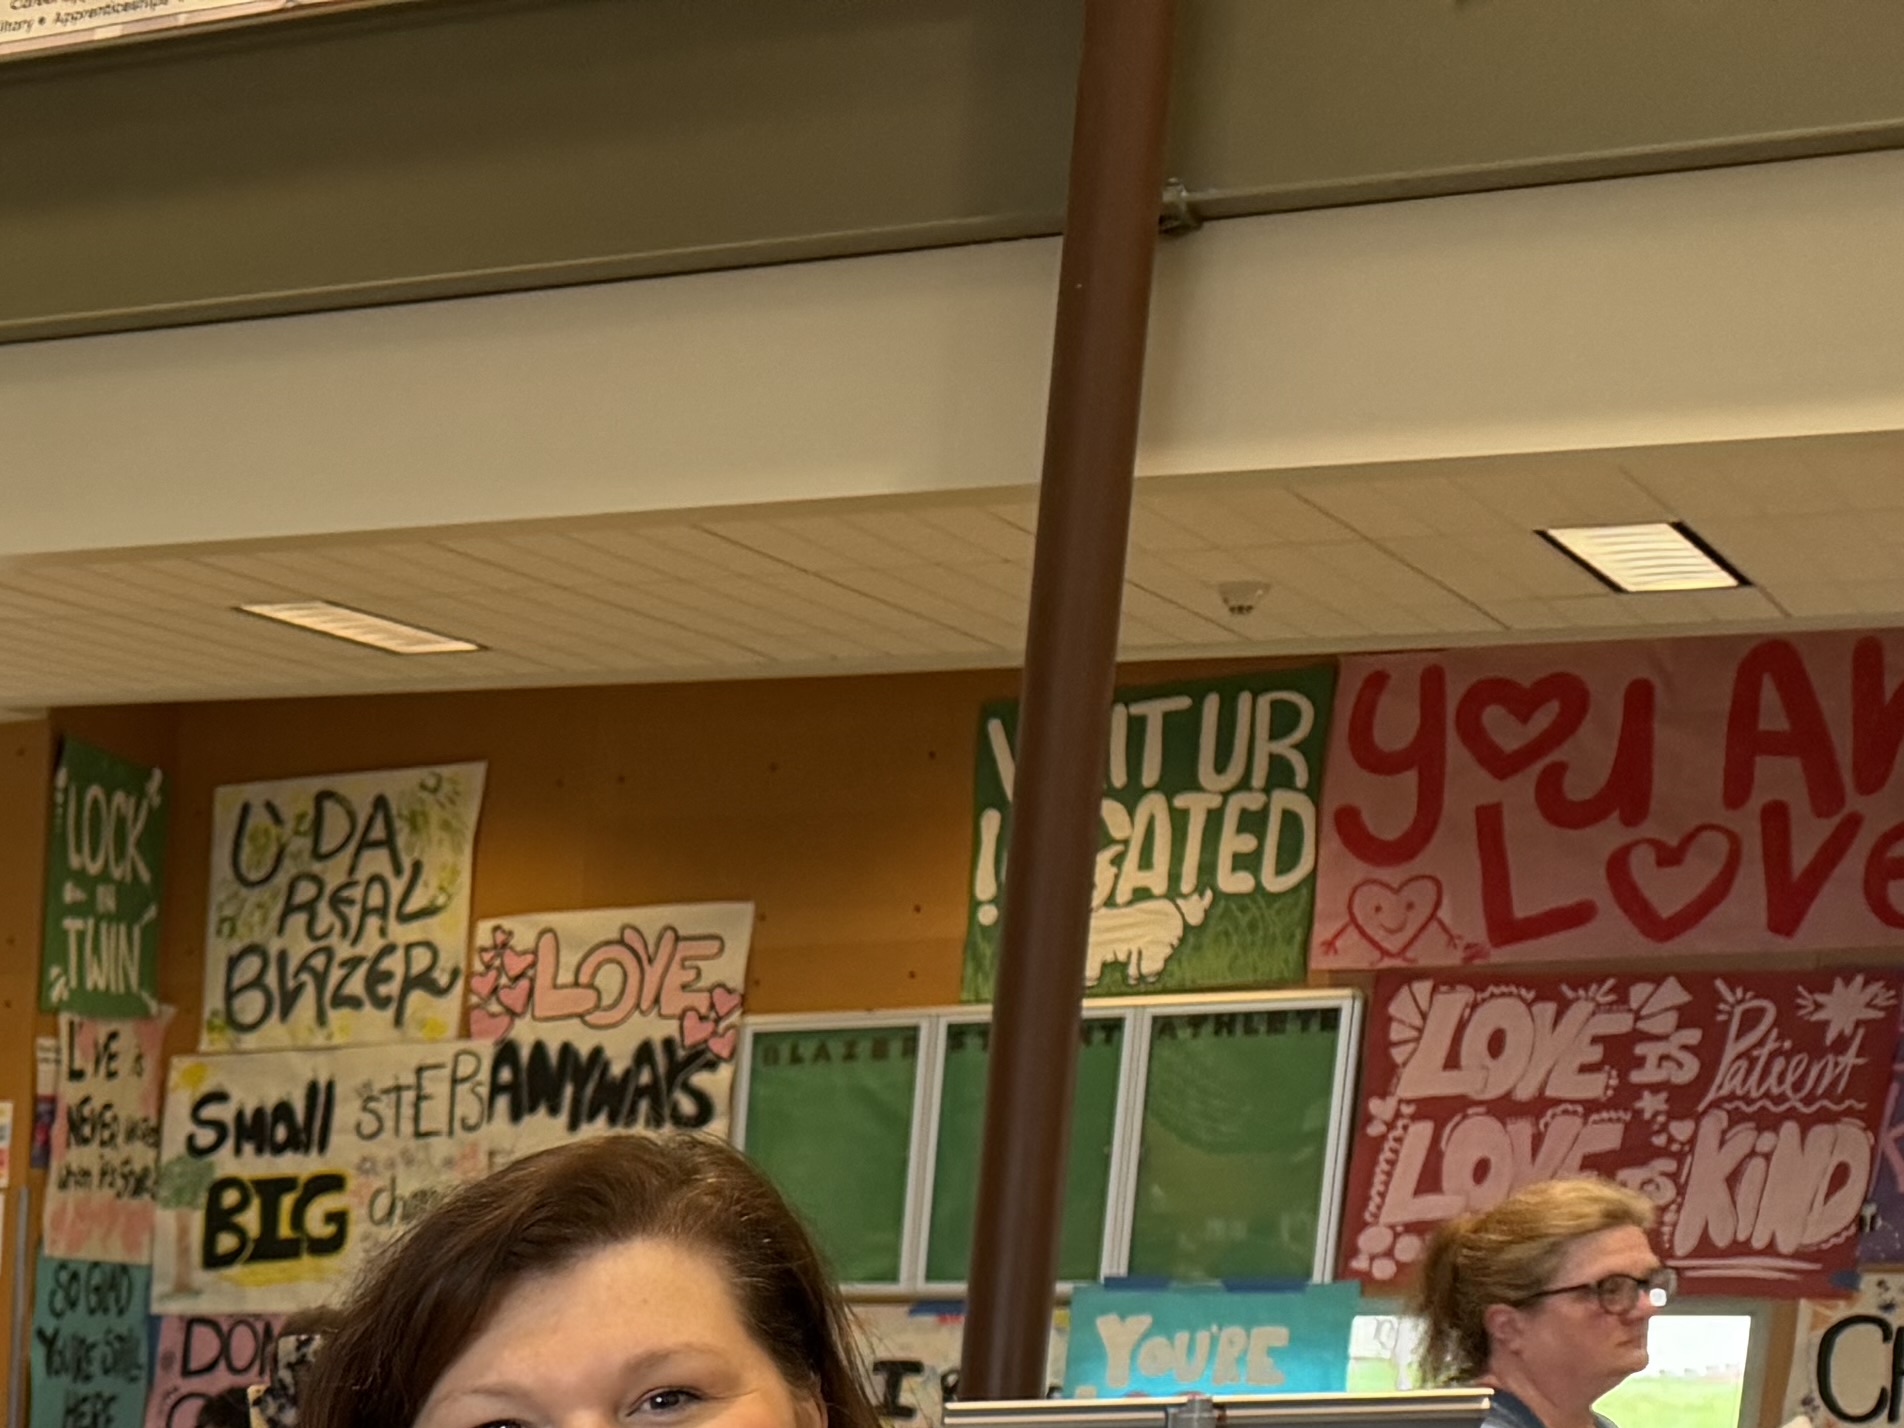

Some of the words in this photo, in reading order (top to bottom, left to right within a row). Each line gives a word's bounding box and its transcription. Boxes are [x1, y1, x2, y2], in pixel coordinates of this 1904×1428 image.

[1197, 688, 1317, 795] UR
[66, 783, 152, 884] LOCK
[231, 800, 285, 888] U
[277, 859, 450, 948] REAL
[224, 941, 461, 1033] BLAZER
[532, 924, 724, 1029] LOVE
[490, 1037, 719, 1133] ANYWAYS
[1395, 989, 1636, 1101] LOVE
[1698, 997, 1868, 1112] Patient
[201, 1172, 349, 1270] BIG
